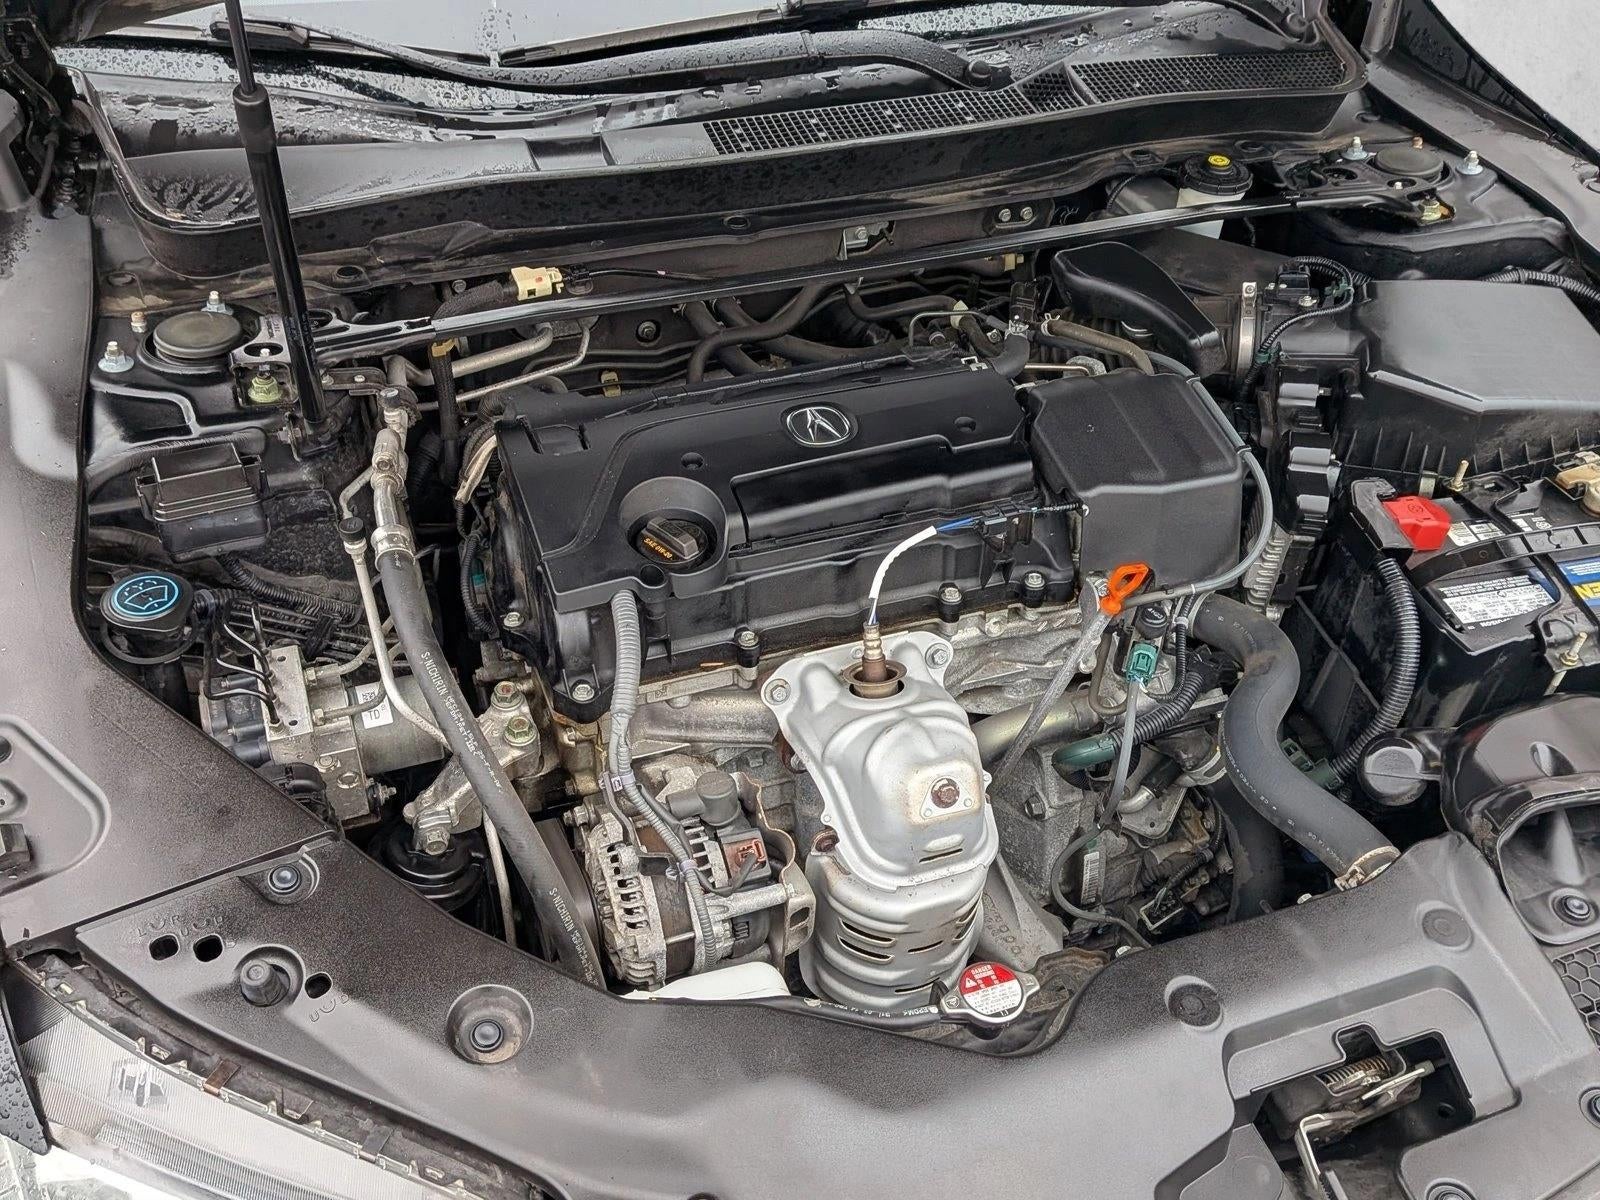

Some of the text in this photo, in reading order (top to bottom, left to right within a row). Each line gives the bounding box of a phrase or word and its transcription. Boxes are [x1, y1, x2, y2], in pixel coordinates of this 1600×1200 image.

[643, 538, 658, 548] SAE
[368, 708, 381, 721] TD
[970, 964, 992, 975] DANGER
